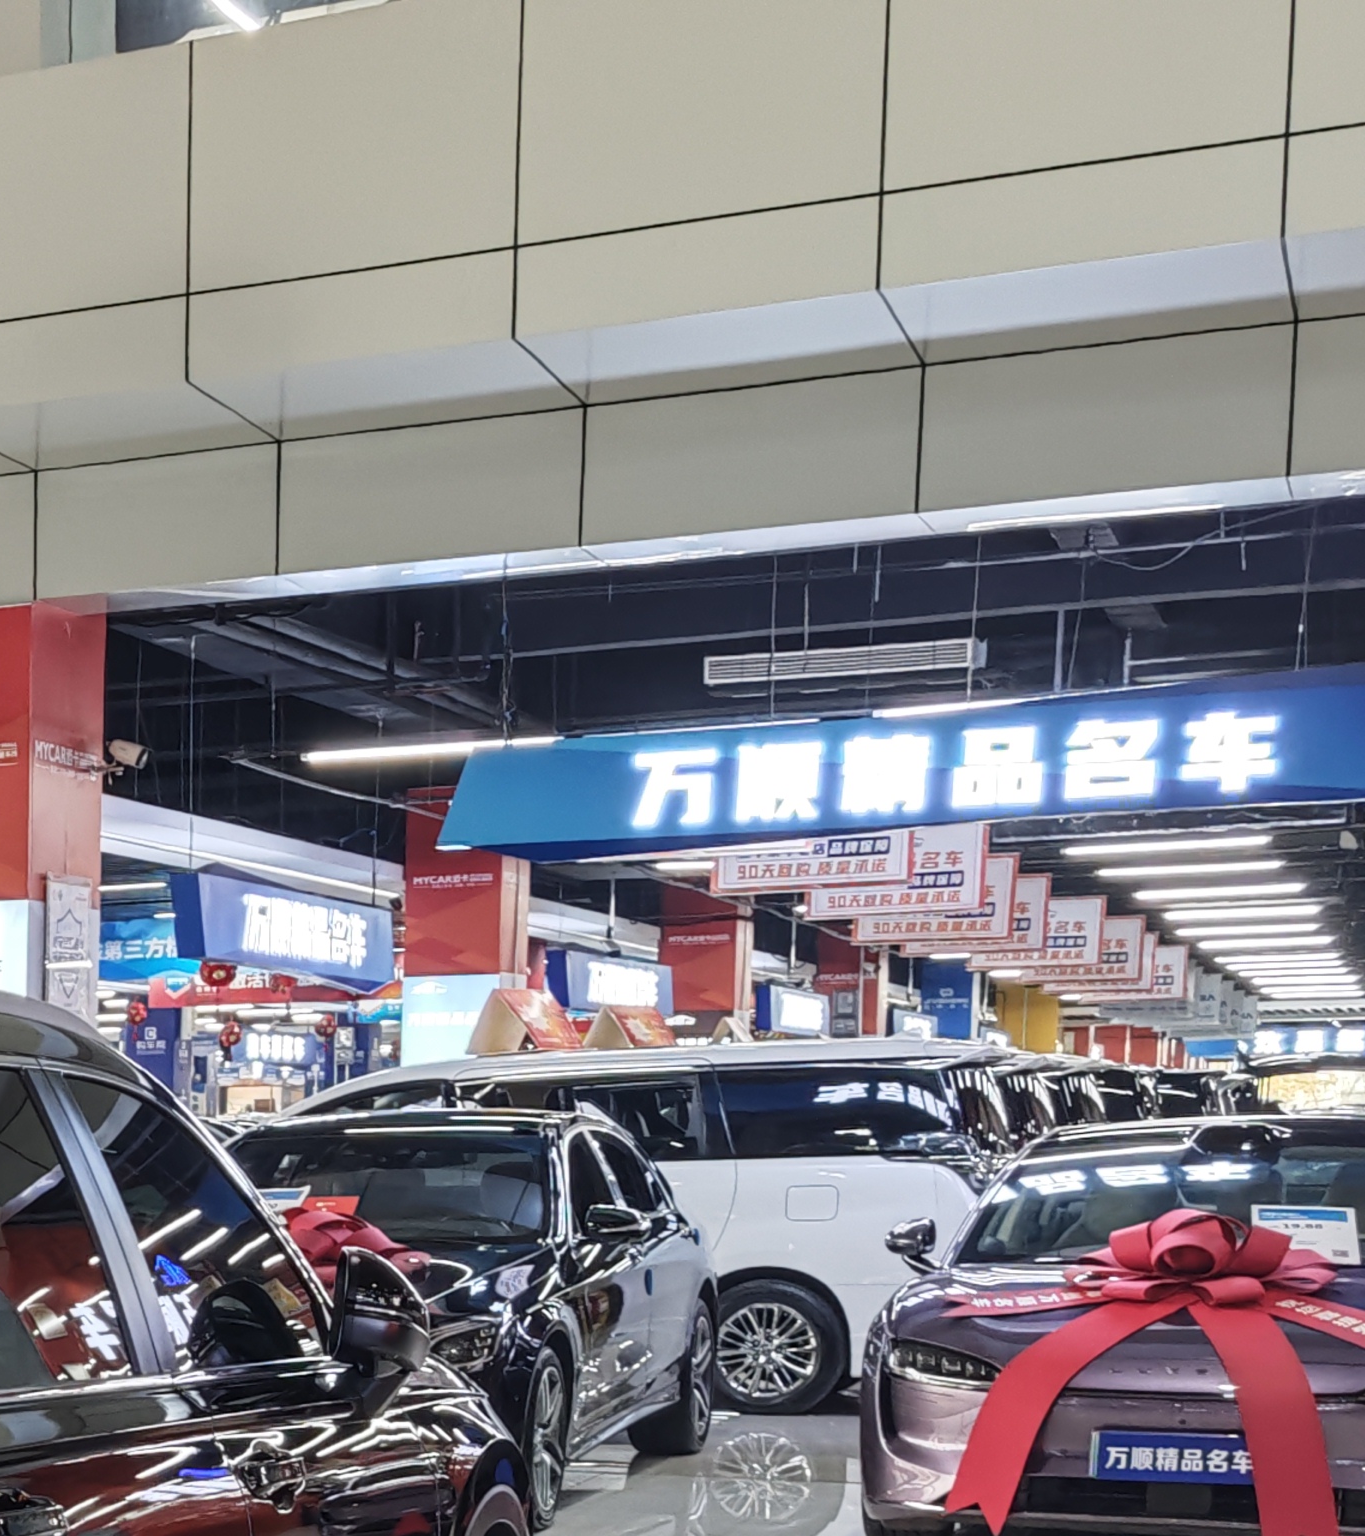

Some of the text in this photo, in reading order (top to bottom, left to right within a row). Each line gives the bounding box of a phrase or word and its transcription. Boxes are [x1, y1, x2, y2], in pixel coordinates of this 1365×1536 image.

[632, 712, 1278, 827] 万顺精品名车
[1105, 1445, 1255, 1475] 万顺精品名车
